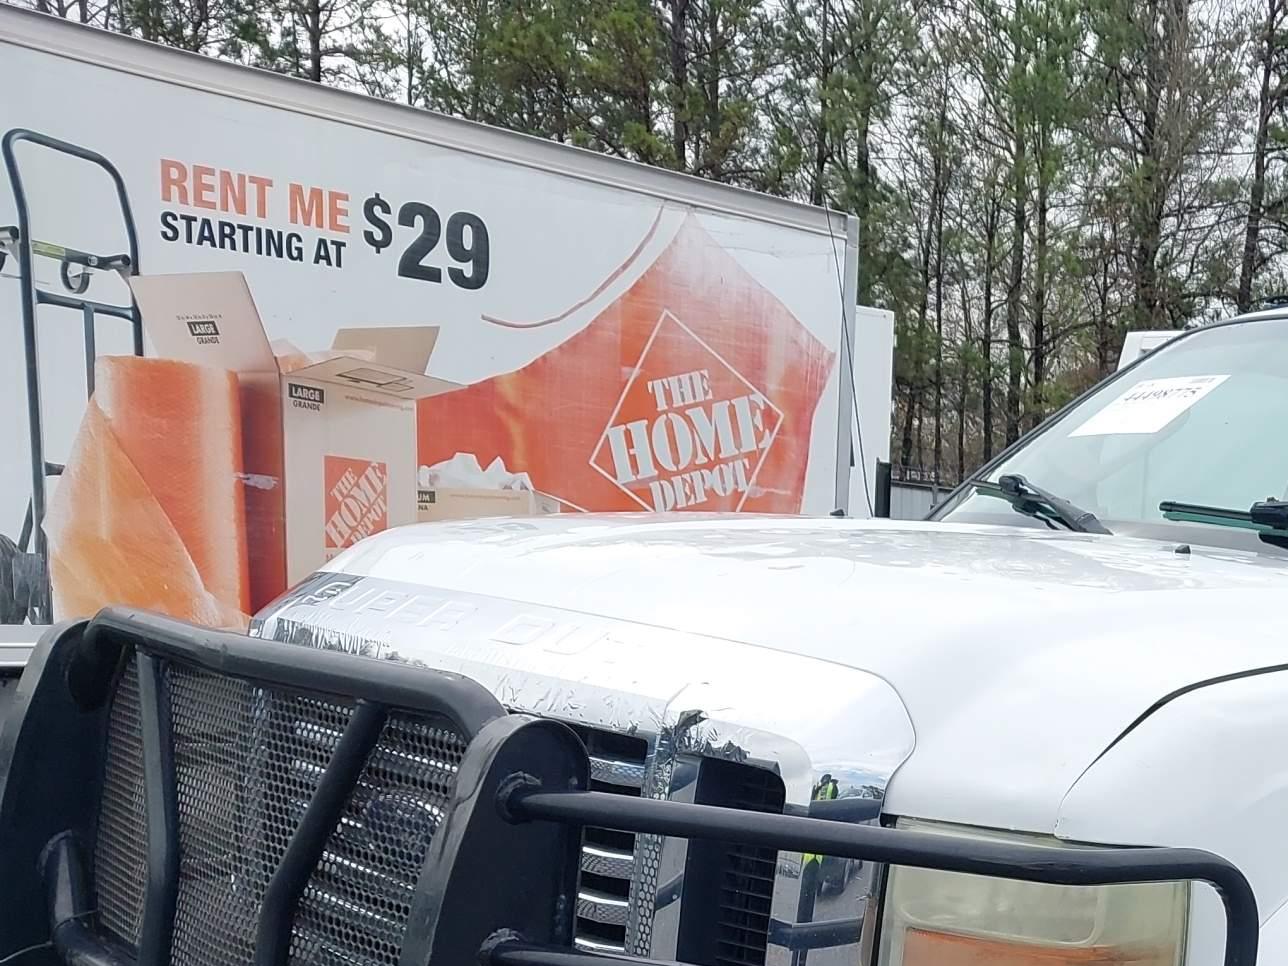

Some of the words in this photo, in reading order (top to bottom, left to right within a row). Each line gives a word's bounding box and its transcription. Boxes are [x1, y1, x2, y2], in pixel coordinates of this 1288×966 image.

[159, 158, 273, 219] RENT
[288, 182, 351, 234] ME
[160, 210, 304, 263] STARTING
[313, 237, 347, 269] AT
[363, 192, 490, 290] $29
[291, 385, 321, 401] LARGE
[647, 369, 713, 412] THE
[607, 391, 772, 485] HOME
[325, 463, 387, 548] HOME
[329, 467, 358, 502] THE
[649, 458, 750, 512] DEPOT
